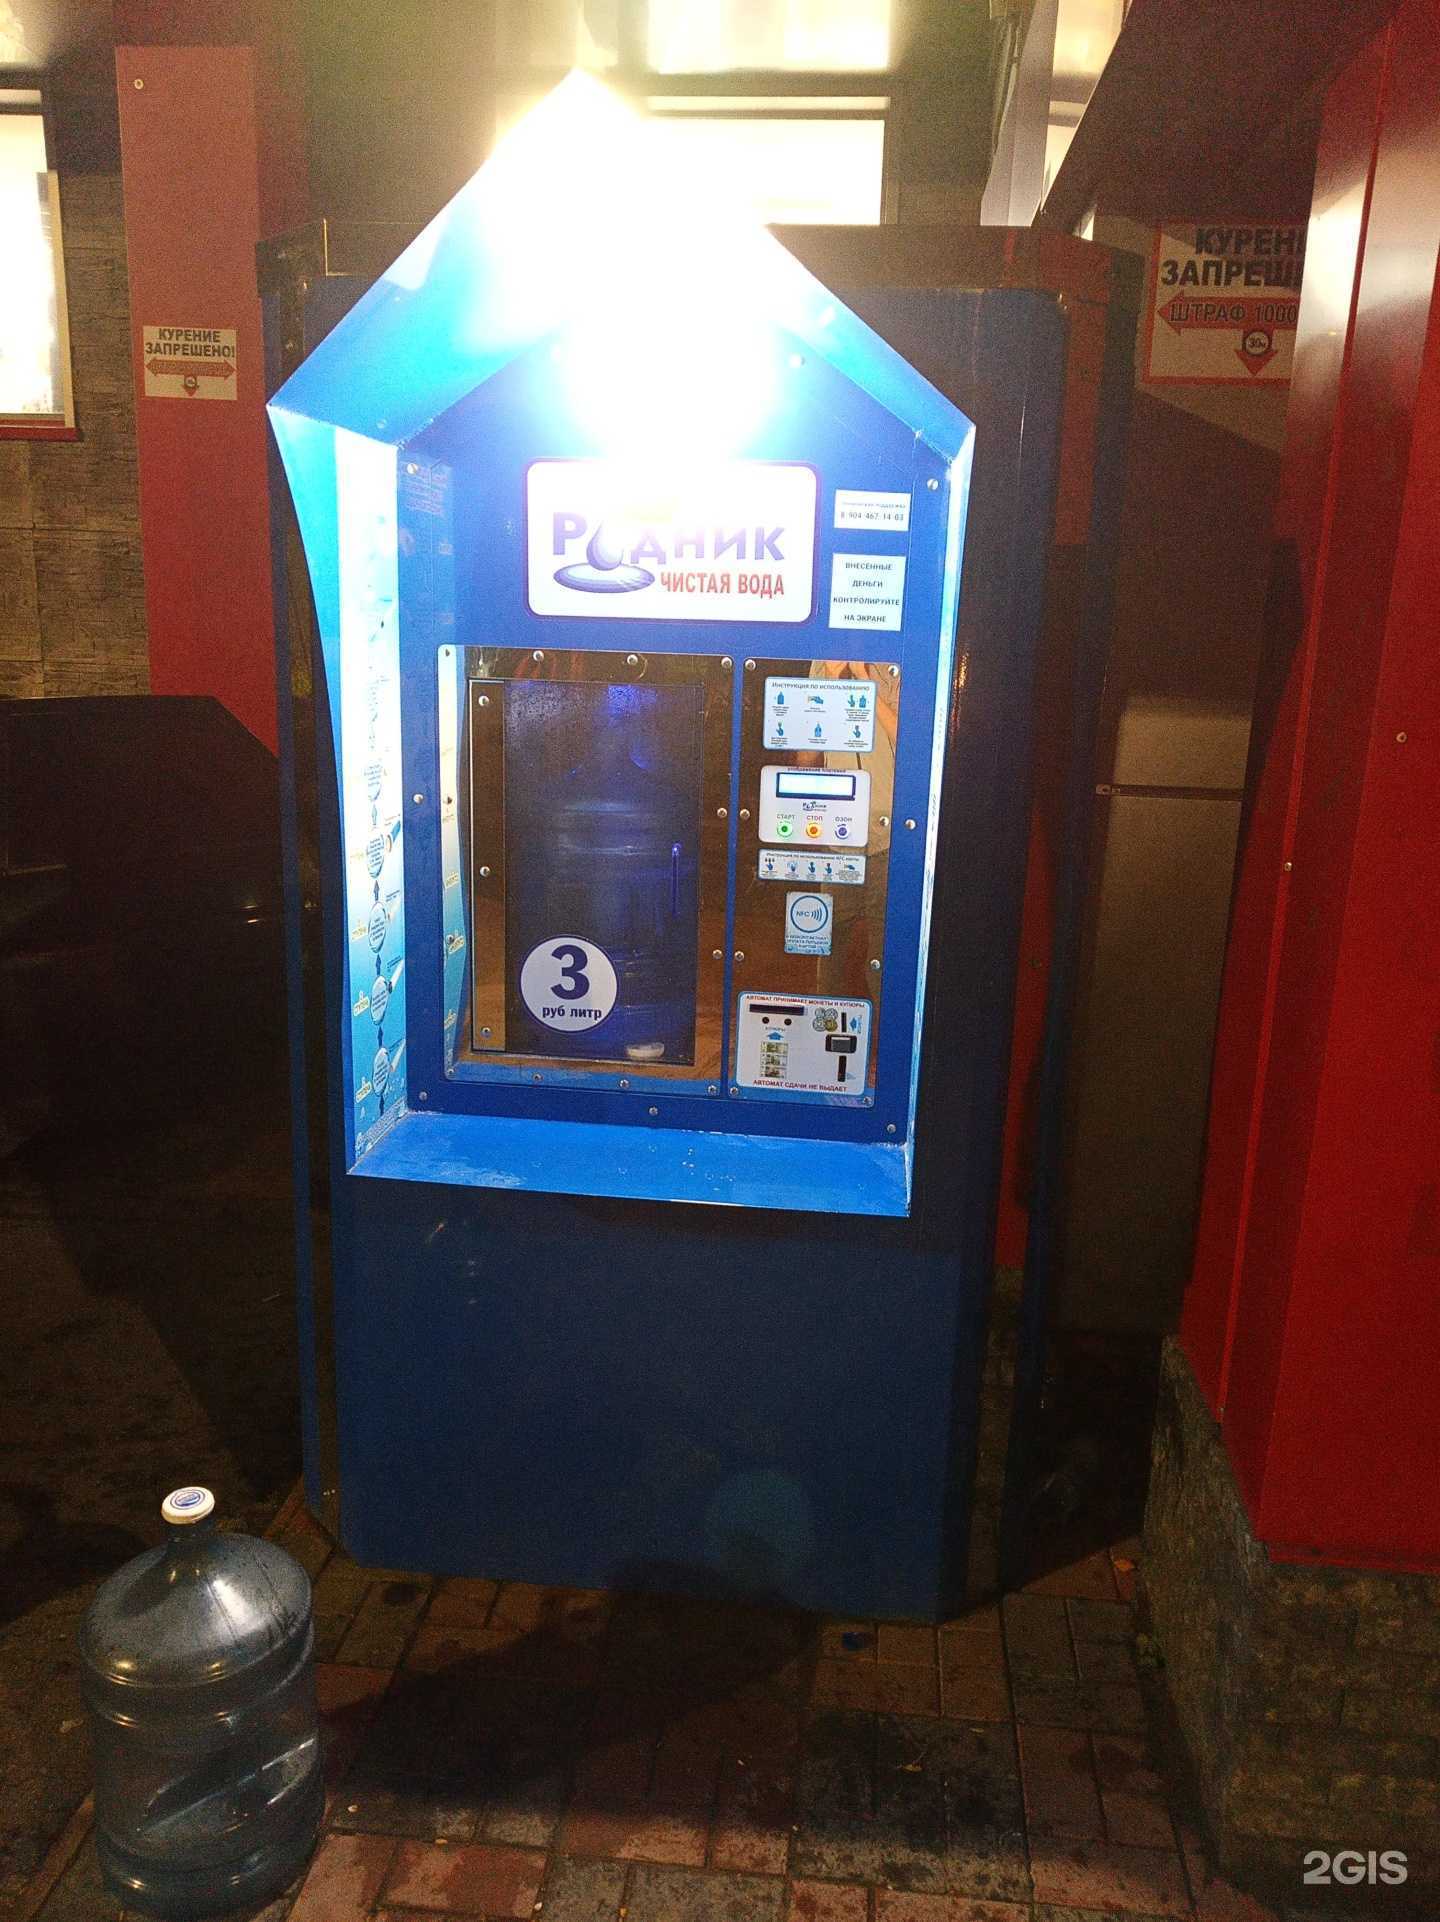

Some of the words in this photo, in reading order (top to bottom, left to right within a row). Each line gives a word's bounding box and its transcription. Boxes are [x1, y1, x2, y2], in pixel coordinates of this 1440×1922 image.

[1170, 303, 1246, 322] ШТРАФ
[1255, 304, 1298, 322] 1000
[158, 328, 221, 343] КУРЕНИЕ
[660, 571, 731, 595] ЧИСТАЯ
[737, 572, 785, 599] ВОДА
[852, 579, 883, 589] ДЕНЬГИ
[833, 596, 901, 606] КОНТРОЛИРУЙТЕ
[844, 614, 855, 622] НА
[857, 614, 887, 623] ЭКРАНЕ
[776, 813, 796, 821] СТАРТ
[550, 944, 590, 1000] 3
[542, 1005, 565, 1019] руб
[570, 1007, 602, 1020] литр
[753, 1079, 783, 1087] АВТОМАТ
[819, 1084, 847, 1092] ВЫДАЕТ
